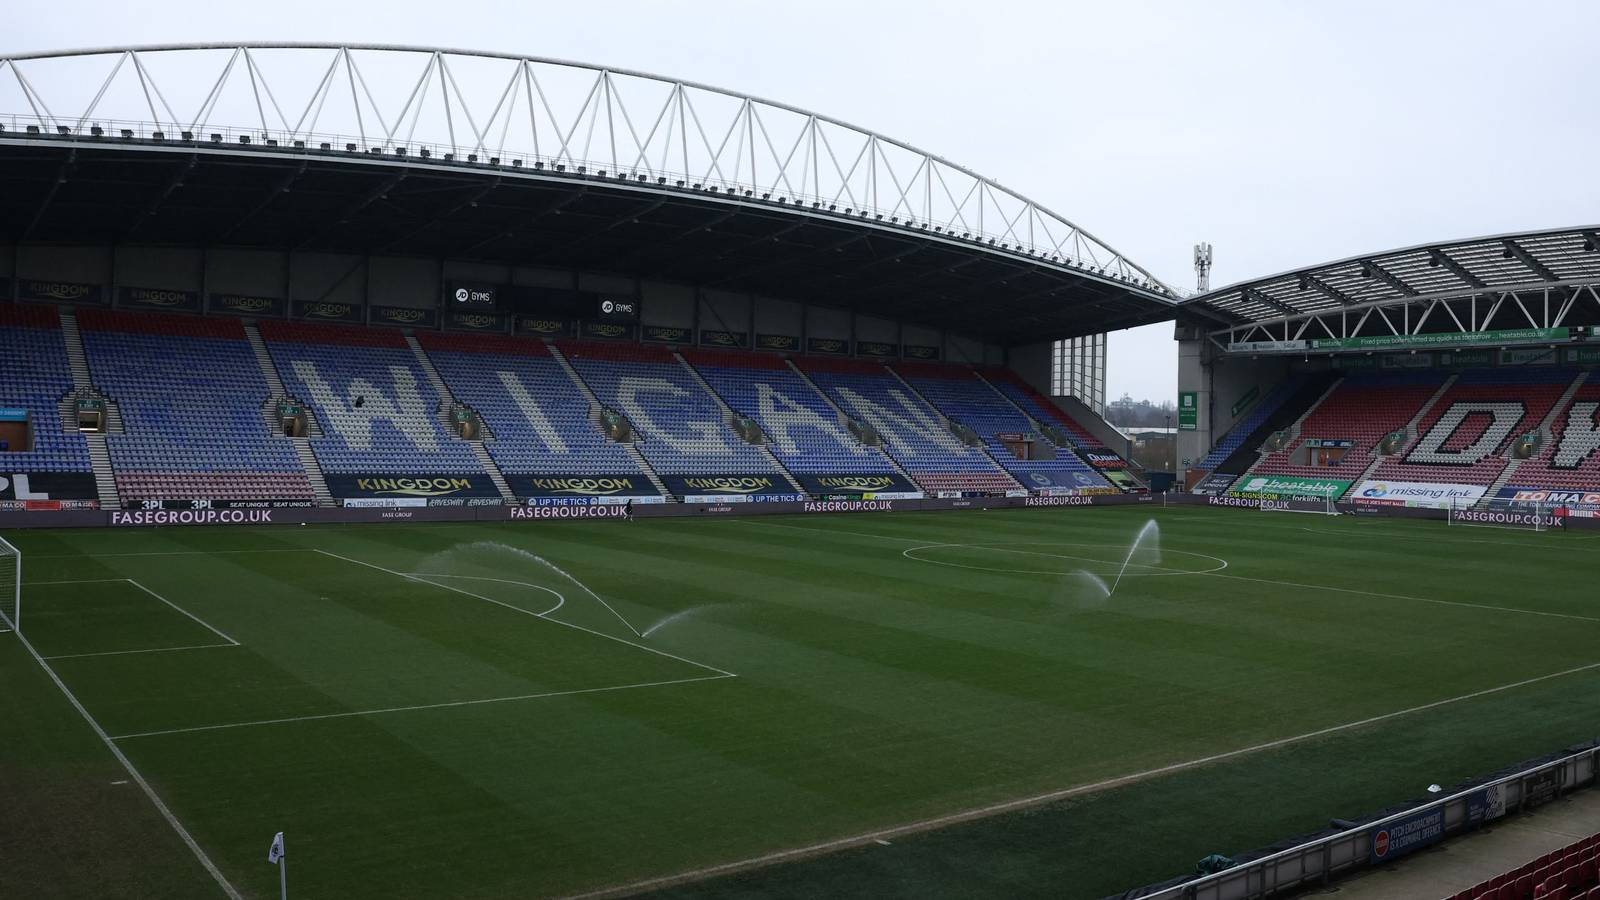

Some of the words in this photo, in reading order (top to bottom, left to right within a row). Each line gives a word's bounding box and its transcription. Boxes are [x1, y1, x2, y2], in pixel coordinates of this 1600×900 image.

[32, 282, 89, 296] KINGDOM
[130, 289, 186, 303] KINGDOM
[471, 292, 490, 302] GYMS
[222, 295, 272, 310] KINGDOM
[304, 302, 351, 315] KINGDOM
[615, 303, 633, 313] GYMS
[382, 309, 425, 321] KINGDOM
[290, 360, 969, 457] WIGAN
[357, 478, 472, 490] KINGDOM
[532, 478, 633, 490] KINGDOM
[684, 478, 773, 489] KINGDOM
[817, 476, 896, 487] KINGDOM
[1268, 479, 1339, 492] heatable
[1390, 487, 1444, 498] missing
[1446, 489, 1472, 497] link
[142, 500, 166, 509] 3PL
[191, 500, 215, 509] 3PL
[551, 498, 568, 506] THE
[804, 500, 892, 512] FASEGROUP.CO.UK
[1025, 496, 1093, 506] FASEGROUP.CO.UK
[112, 510, 272, 524] FASEGROUP.CO.UK
[510, 506, 627, 518] FASEGROUP.CO.UK
[1454, 510, 1562, 526] FASEGROUP.CO.UK
